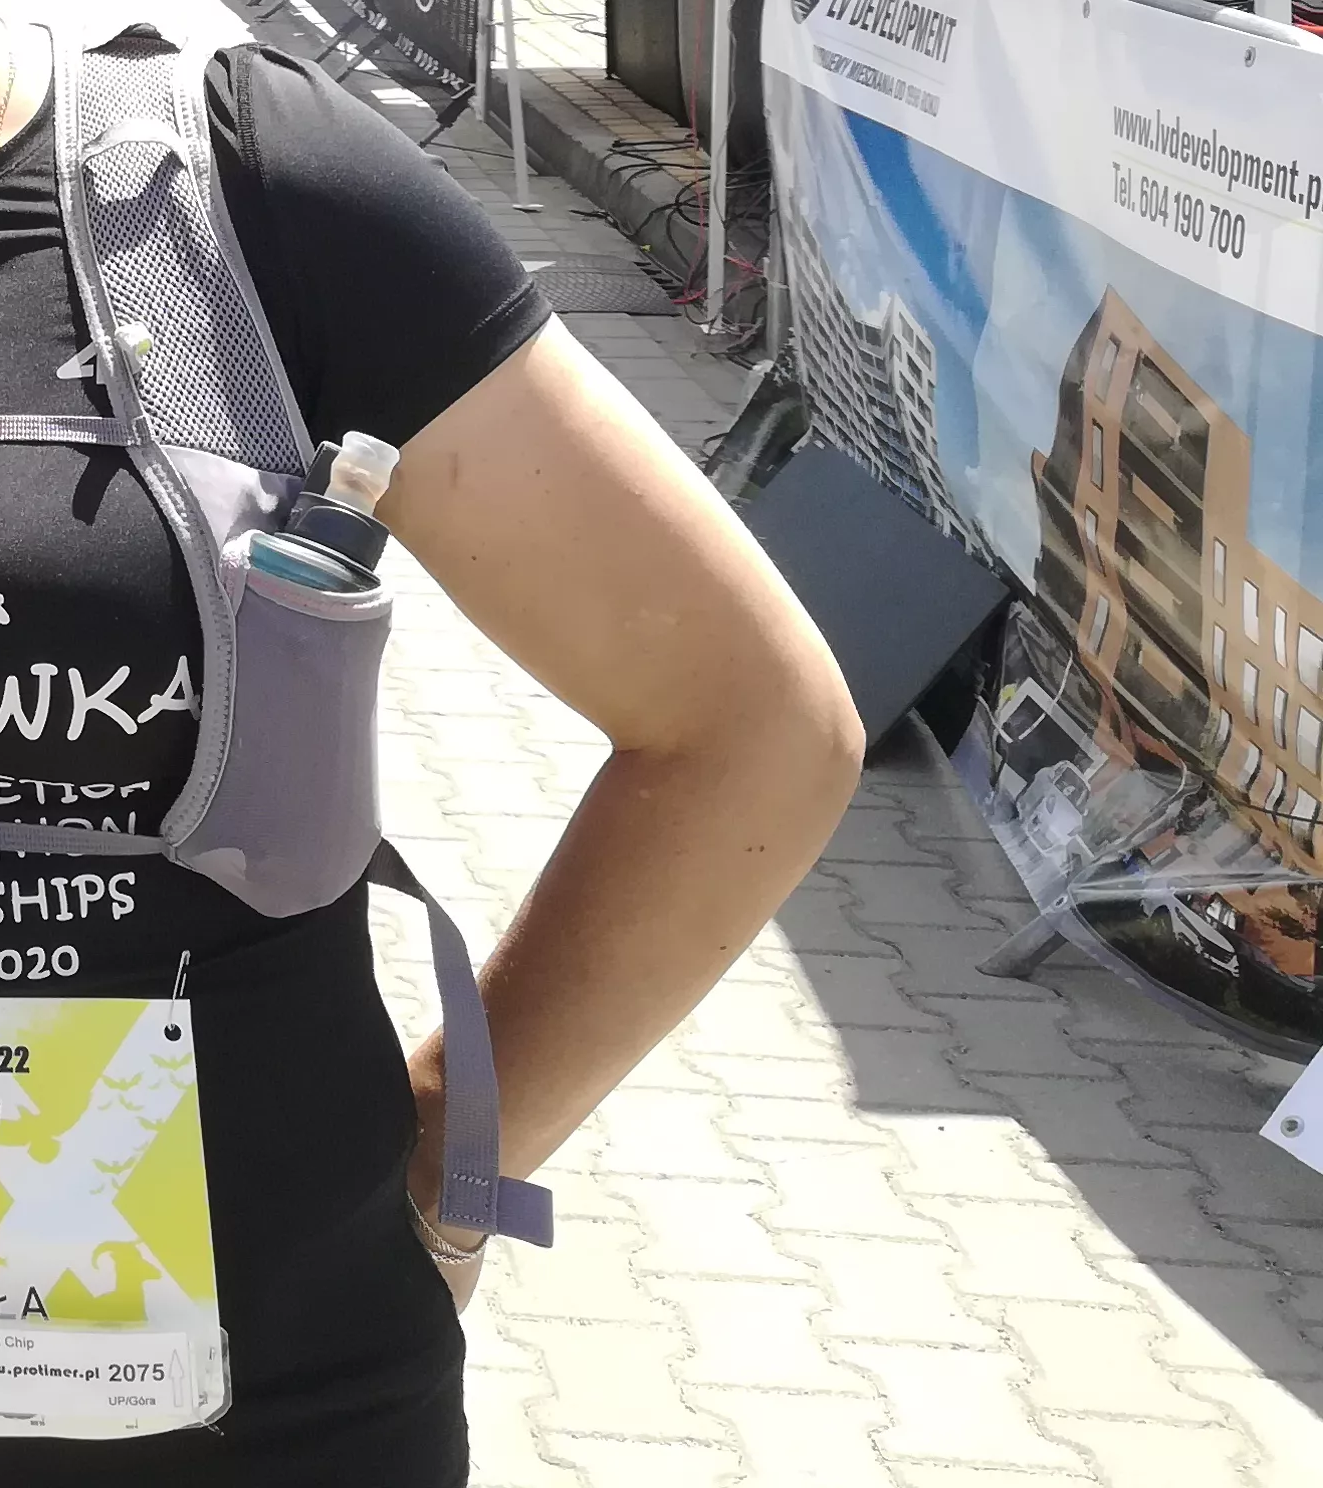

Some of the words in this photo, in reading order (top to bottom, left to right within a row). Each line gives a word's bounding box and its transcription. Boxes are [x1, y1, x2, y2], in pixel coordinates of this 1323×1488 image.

[1113, 106, 1323, 220] www.lvdevelopment.p
[1112, 161, 1136, 213] Tel.
[1139, 175, 1170, 228] 604
[1173, 190, 1205, 243] 190
[1208, 203, 1246, 260] 700
[4, 1334, 36, 1352] Chip
[108, 1362, 166, 1383] 2075
[108, 1395, 157, 1407] UP/Góra
